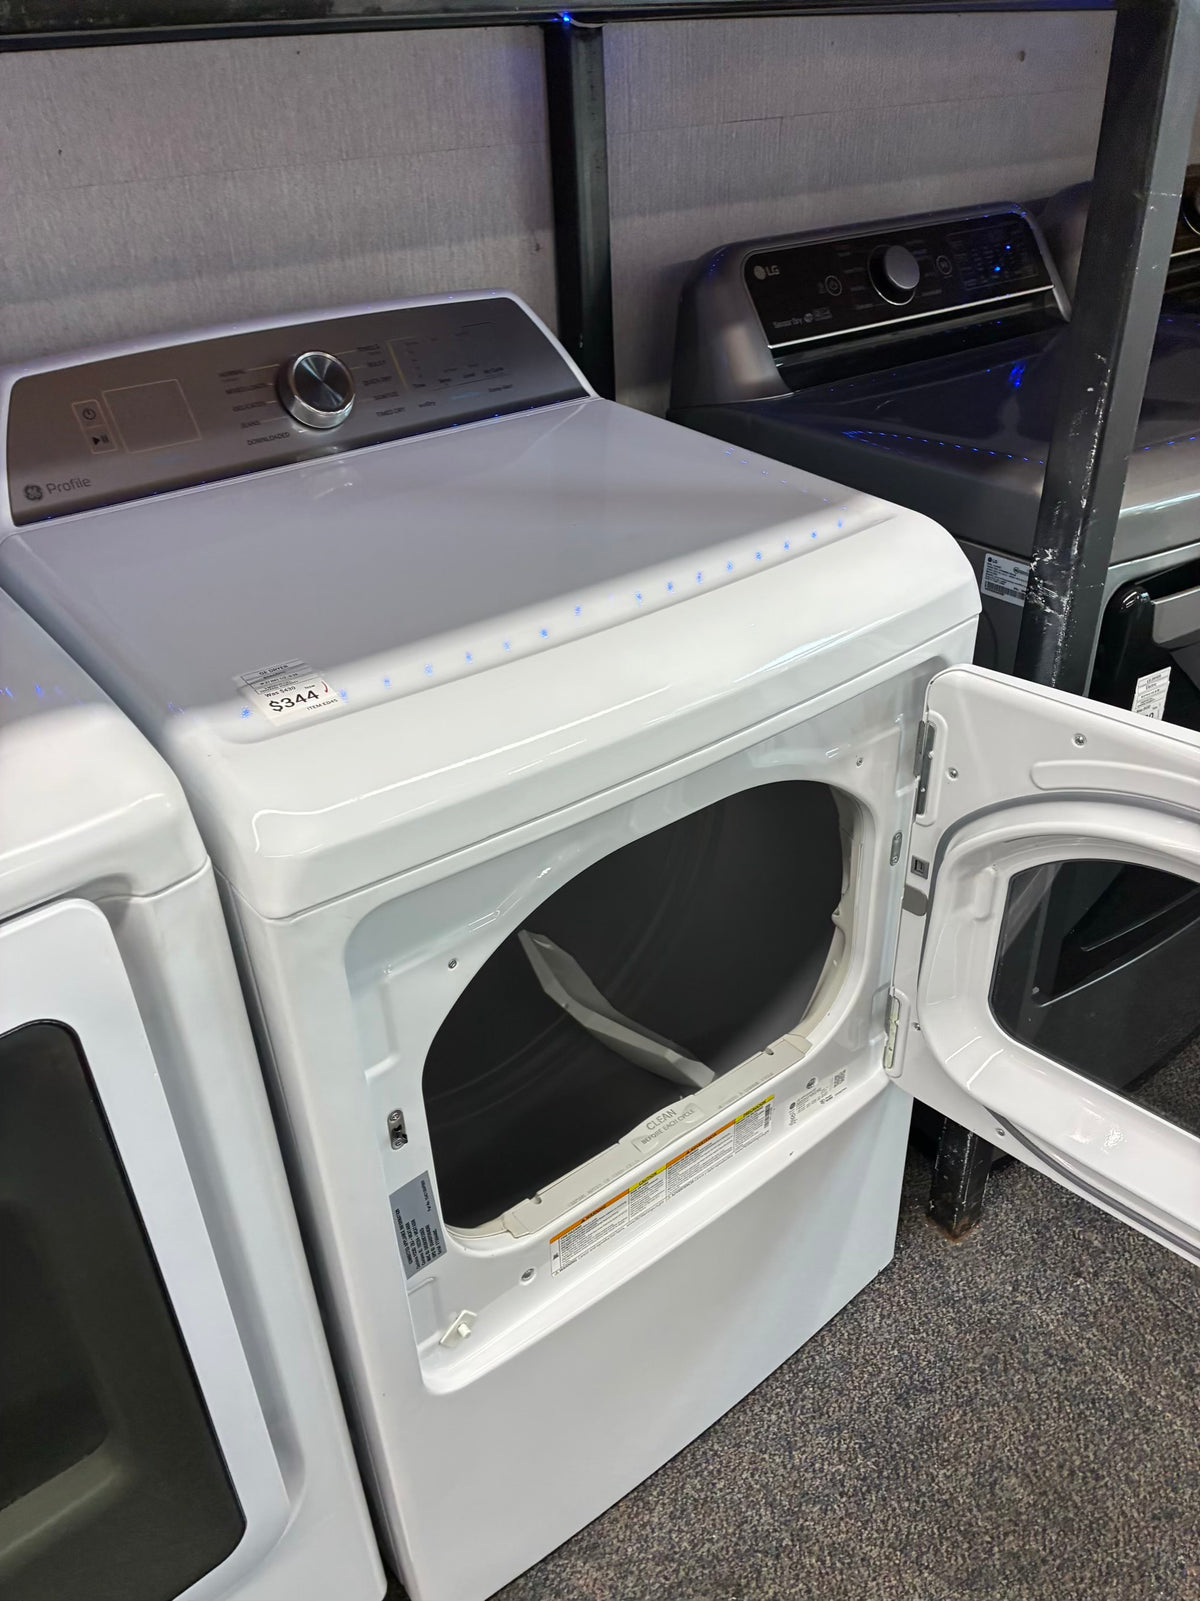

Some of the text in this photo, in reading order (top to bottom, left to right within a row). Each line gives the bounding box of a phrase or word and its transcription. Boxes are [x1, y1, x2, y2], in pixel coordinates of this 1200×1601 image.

[765, 264, 780, 276] LG
[247, 432, 290, 446] DOWNLOADED
[46, 478, 91, 495] Profile
[269, 690, 319, 712] $344
[307, 703, 322, 711] ITEM
[641, 1109, 695, 1146] BEFORE EACH CYCLE
[646, 1109, 677, 1130] CLEAN
